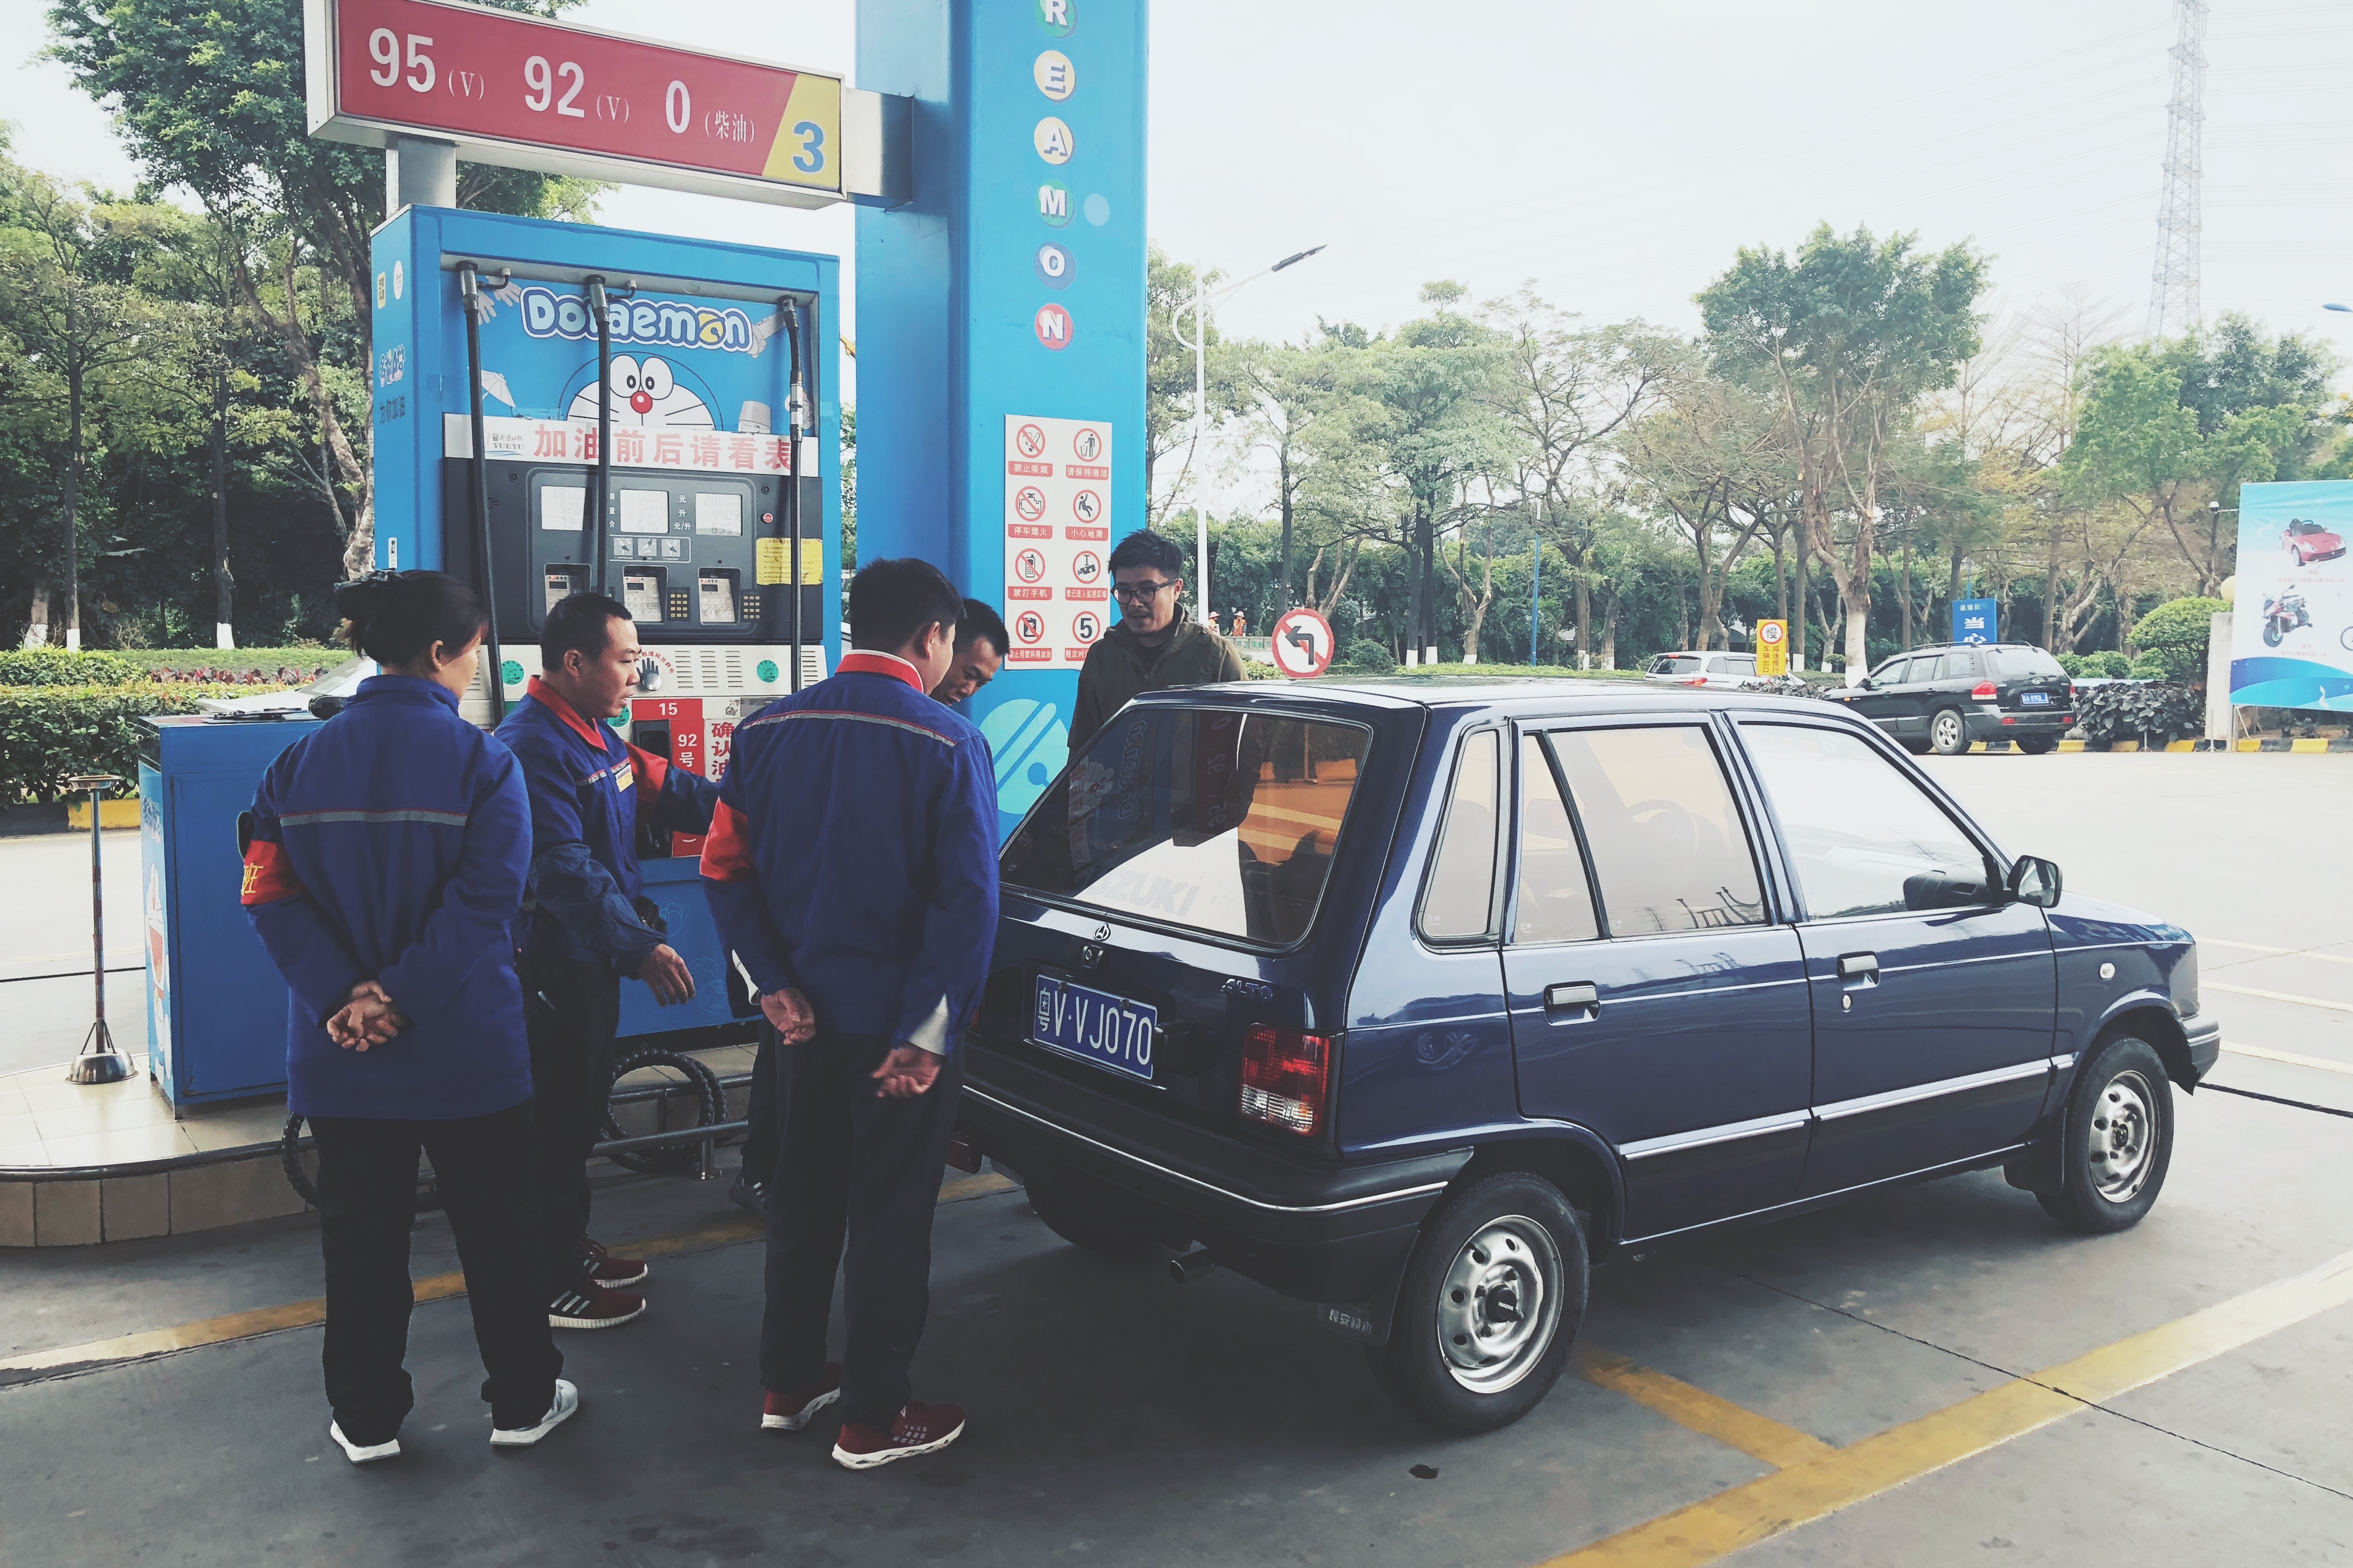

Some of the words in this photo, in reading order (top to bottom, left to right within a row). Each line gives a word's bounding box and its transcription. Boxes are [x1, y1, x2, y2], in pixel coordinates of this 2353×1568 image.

[369, 28, 436, 93] 95
[448, 71, 485, 101] (V)
[524, 56, 586, 118] 92
[596, 93, 630, 125] (V)
[665, 80, 691, 134] 0
[704, 109, 756, 144] (柴油)
[792, 121, 825, 173] 3
[1014, 463, 1048, 474] 禁止吸烟
[1067, 467, 1107, 477] 请保持清洁
[678, 495, 687, 503] 元
[678, 509, 687, 518] 升
[674, 521, 691, 531] 元/升
[1014, 526, 1047, 536] 停车熄火
[1070, 528, 1103, 538] 小心地滑
[1013, 587, 1048, 598] 禁打手机
[1080, 617, 1092, 638] 5
[1766, 627, 1777, 639] 慢
[659, 702, 678, 716] 15
[1084, 869, 1201, 917] UZUKI
[1220, 979, 1273, 1000] ALTO
